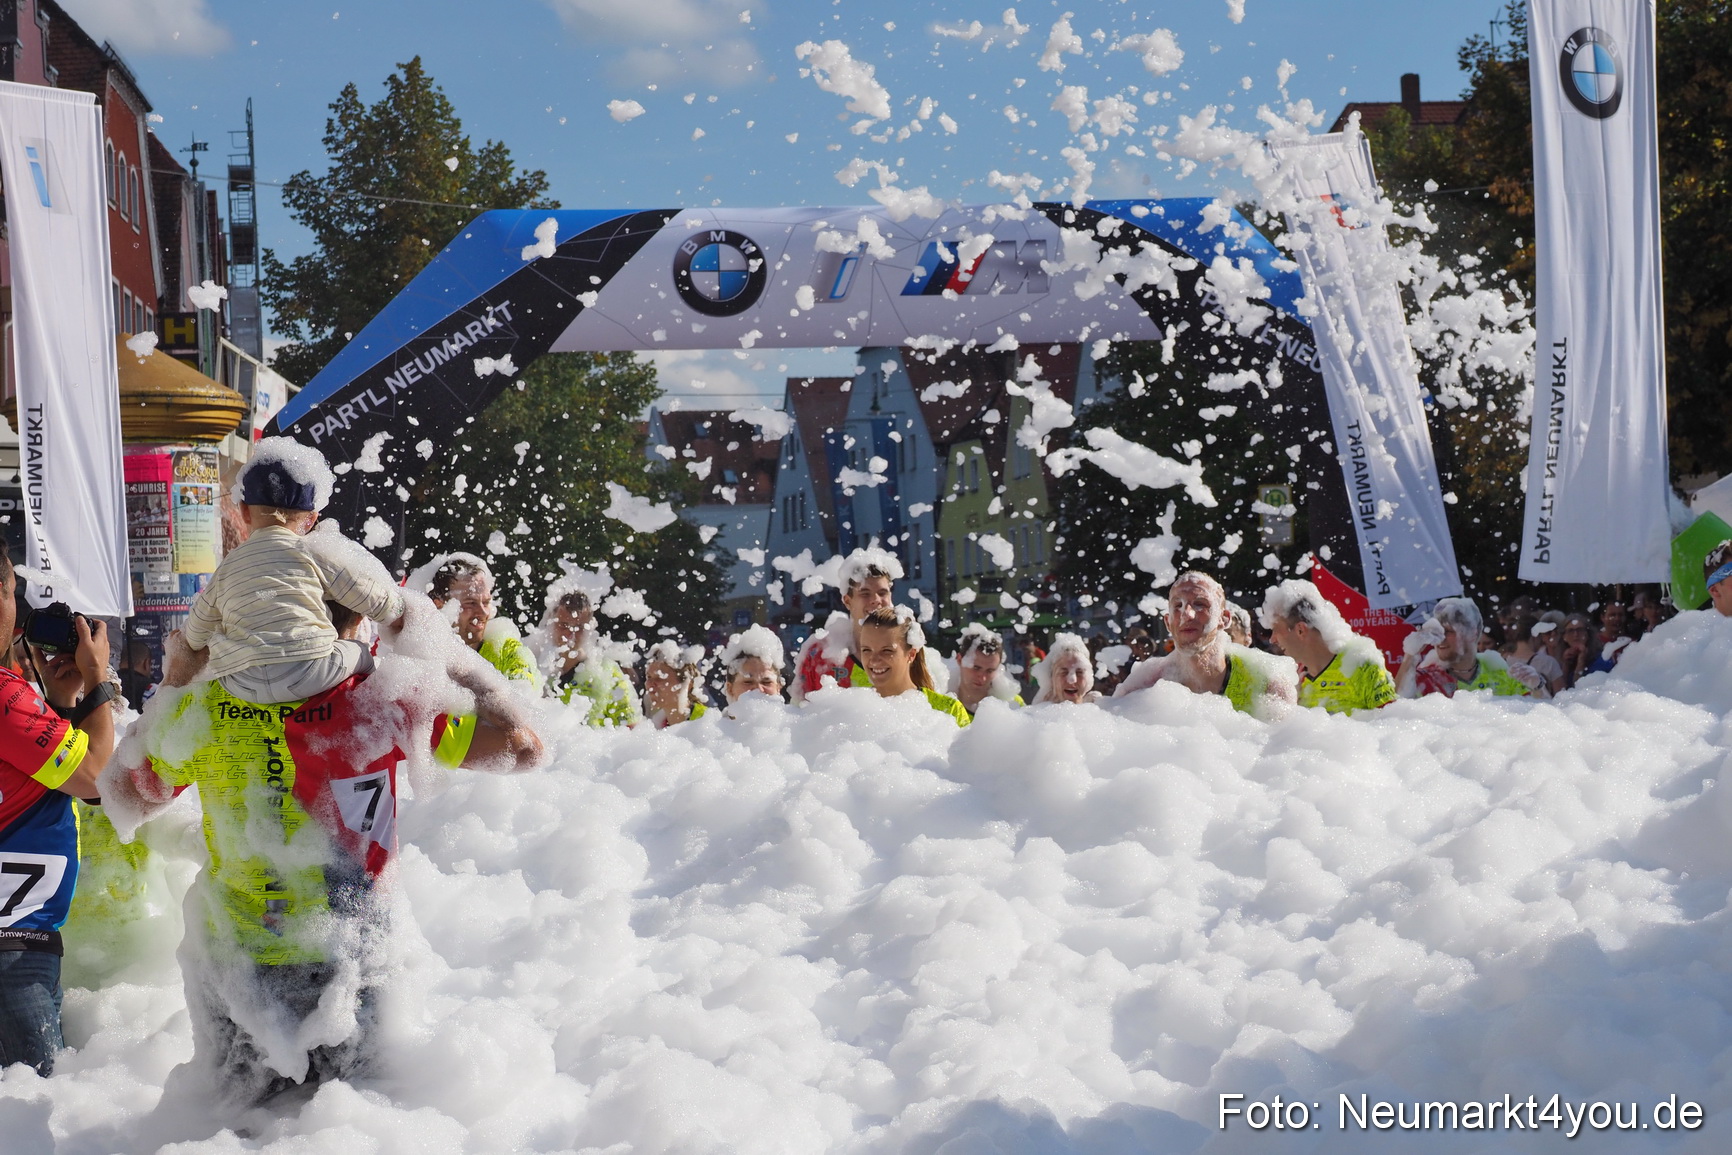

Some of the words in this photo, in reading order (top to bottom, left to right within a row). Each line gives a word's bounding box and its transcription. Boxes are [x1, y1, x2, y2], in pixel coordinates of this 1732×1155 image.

[680, 231, 754, 256] BMW
[309, 388, 388, 445] PARTL
[384, 300, 514, 395] NEUMARKT
[136, 528, 144, 536] 20
[146, 527, 168, 536] JAHRE
[1350, 618, 1364, 628] 100
[1366, 616, 1398, 626] YEARS
[1363, 608, 1382, 617] THE
[1384, 606, 1408, 616] NEXT
[218, 701, 272, 722] Team
[280, 702, 332, 724] Partl
[354, 774, 386, 832] 7
[0, 862, 46, 916] 7
